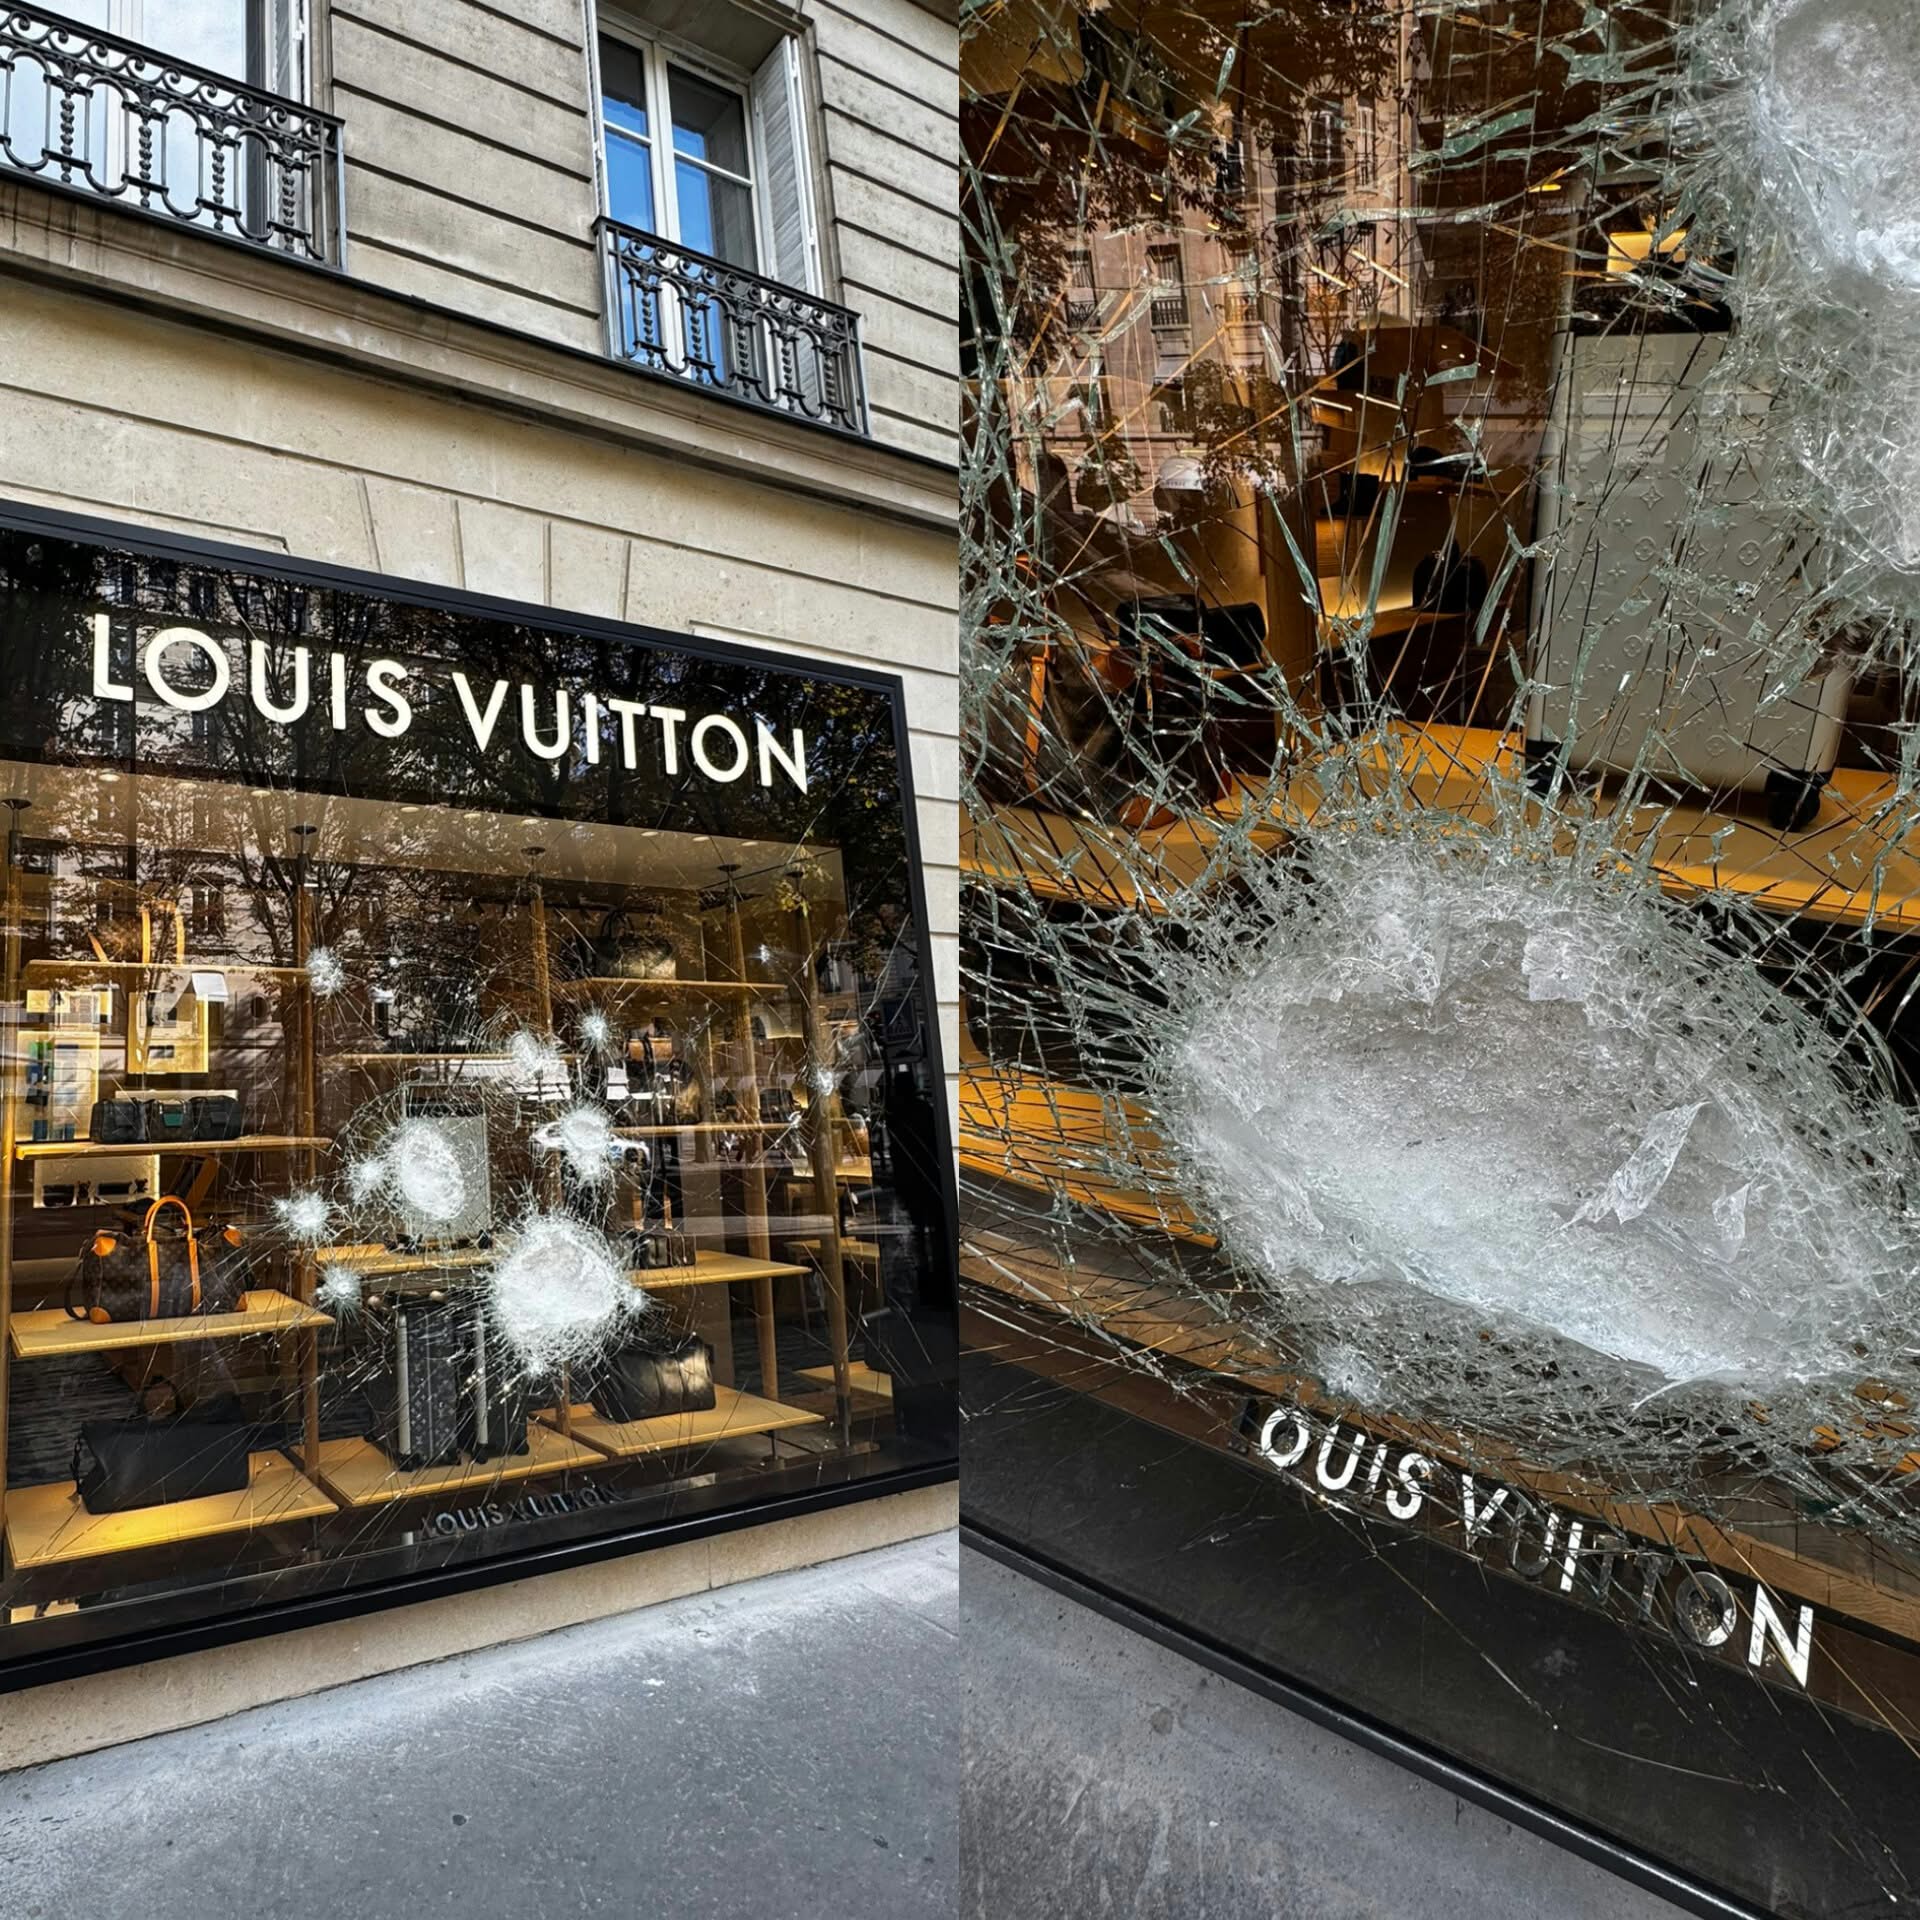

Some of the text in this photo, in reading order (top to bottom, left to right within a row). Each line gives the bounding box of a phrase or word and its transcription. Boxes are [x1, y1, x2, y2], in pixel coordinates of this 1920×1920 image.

[92, 613, 808, 795] LOUIS VUITTON
[1461, 1473, 1814, 1688] VUITTON
